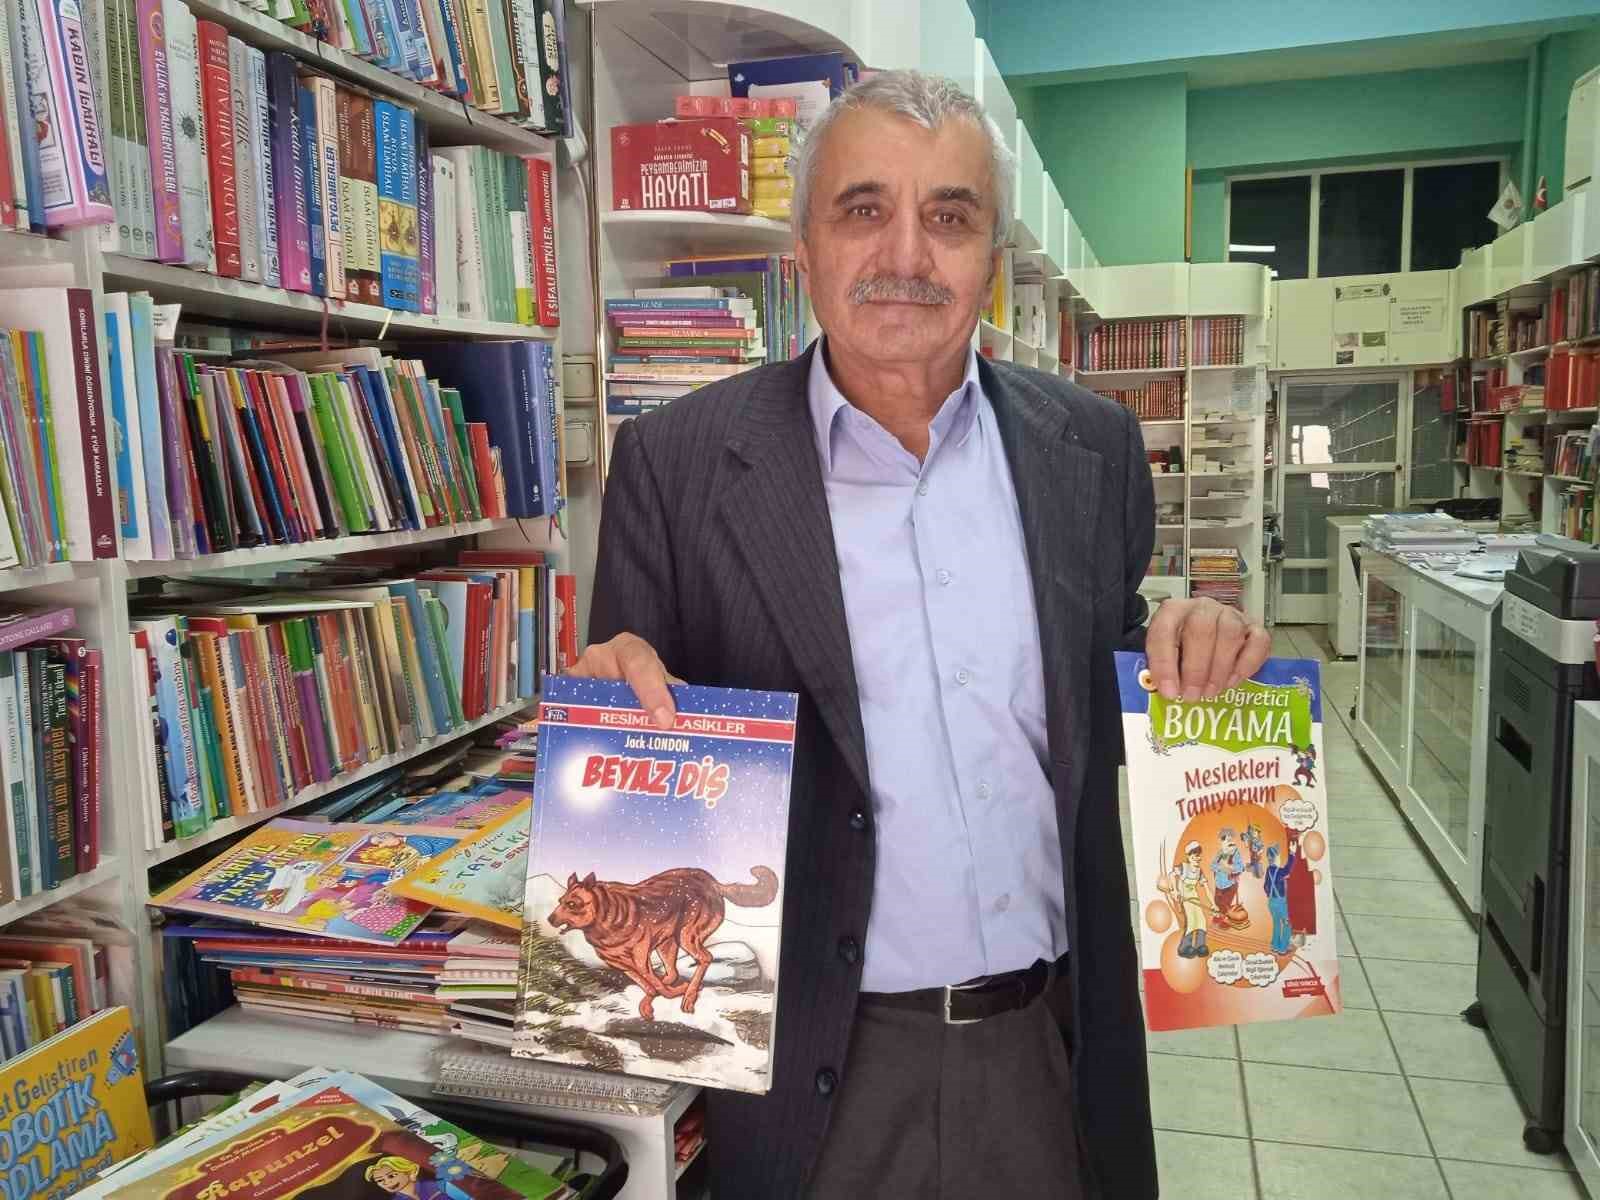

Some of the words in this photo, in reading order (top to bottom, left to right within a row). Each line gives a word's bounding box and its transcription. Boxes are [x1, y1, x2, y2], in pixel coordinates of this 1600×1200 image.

[67, 27, 88, 84] KADIN
[222, 177, 238, 240] KADIN
[324, 144, 340, 233] PEYGAMBERLER
[641, 172, 709, 209] HAYATI
[543, 225, 557, 275] BİTKİLER
[599, 712, 657, 727] RESİML
[673, 718, 746, 734] LASİKLER
[624, 735, 646, 749] Jack
[649, 737, 690, 752] LONDON
[1164, 704, 1293, 743] BOYAMA
[581, 755, 674, 797] BEYAZ
[675, 755, 730, 809] DİŞ
[1184, 757, 1281, 792] Meslekleri
[1175, 785, 1277, 821] Tanıyorum
[0, 1072, 101, 1171] OBOTİK
[195, 1125, 345, 1200] Rapunzel
